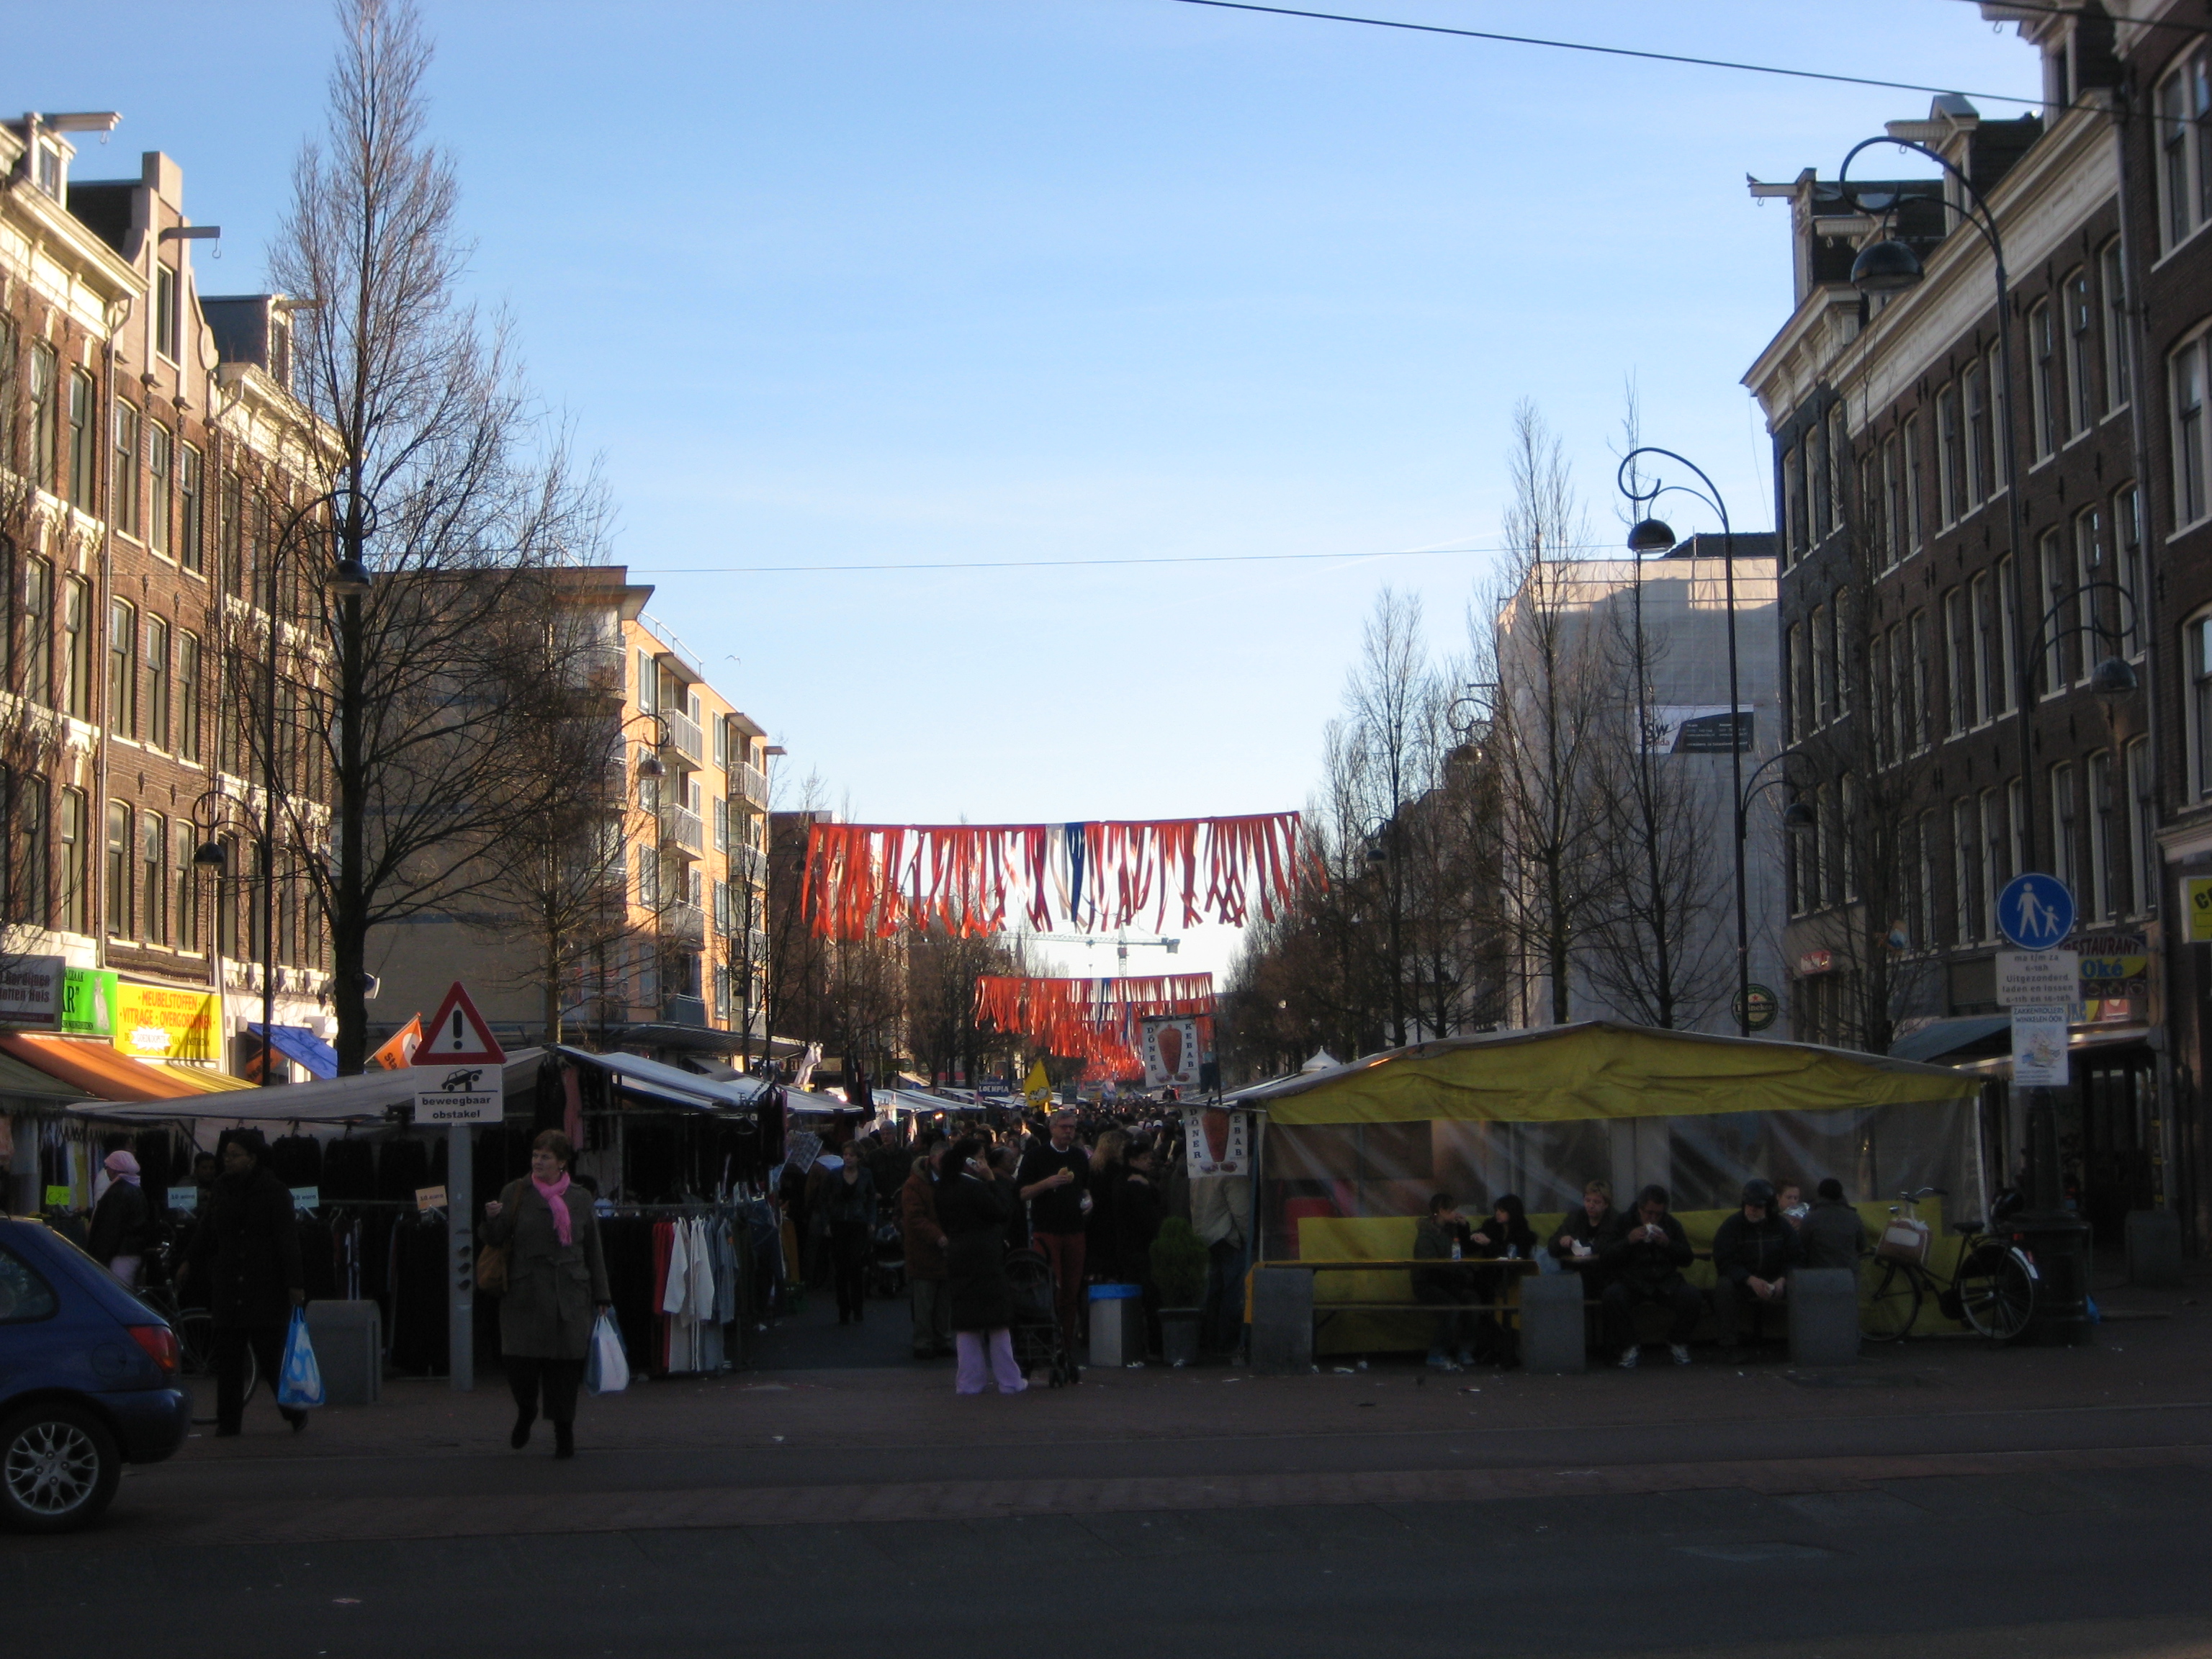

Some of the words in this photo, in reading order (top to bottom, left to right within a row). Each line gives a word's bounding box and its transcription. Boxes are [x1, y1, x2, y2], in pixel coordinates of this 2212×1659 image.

[142, 990, 197, 1011] MEUBELSTOFFEN
[122, 1007, 153, 1025] VITRAGE
[422, 1097, 492, 1107] beweegbaar
[433, 1110, 481, 1119] obstakel
